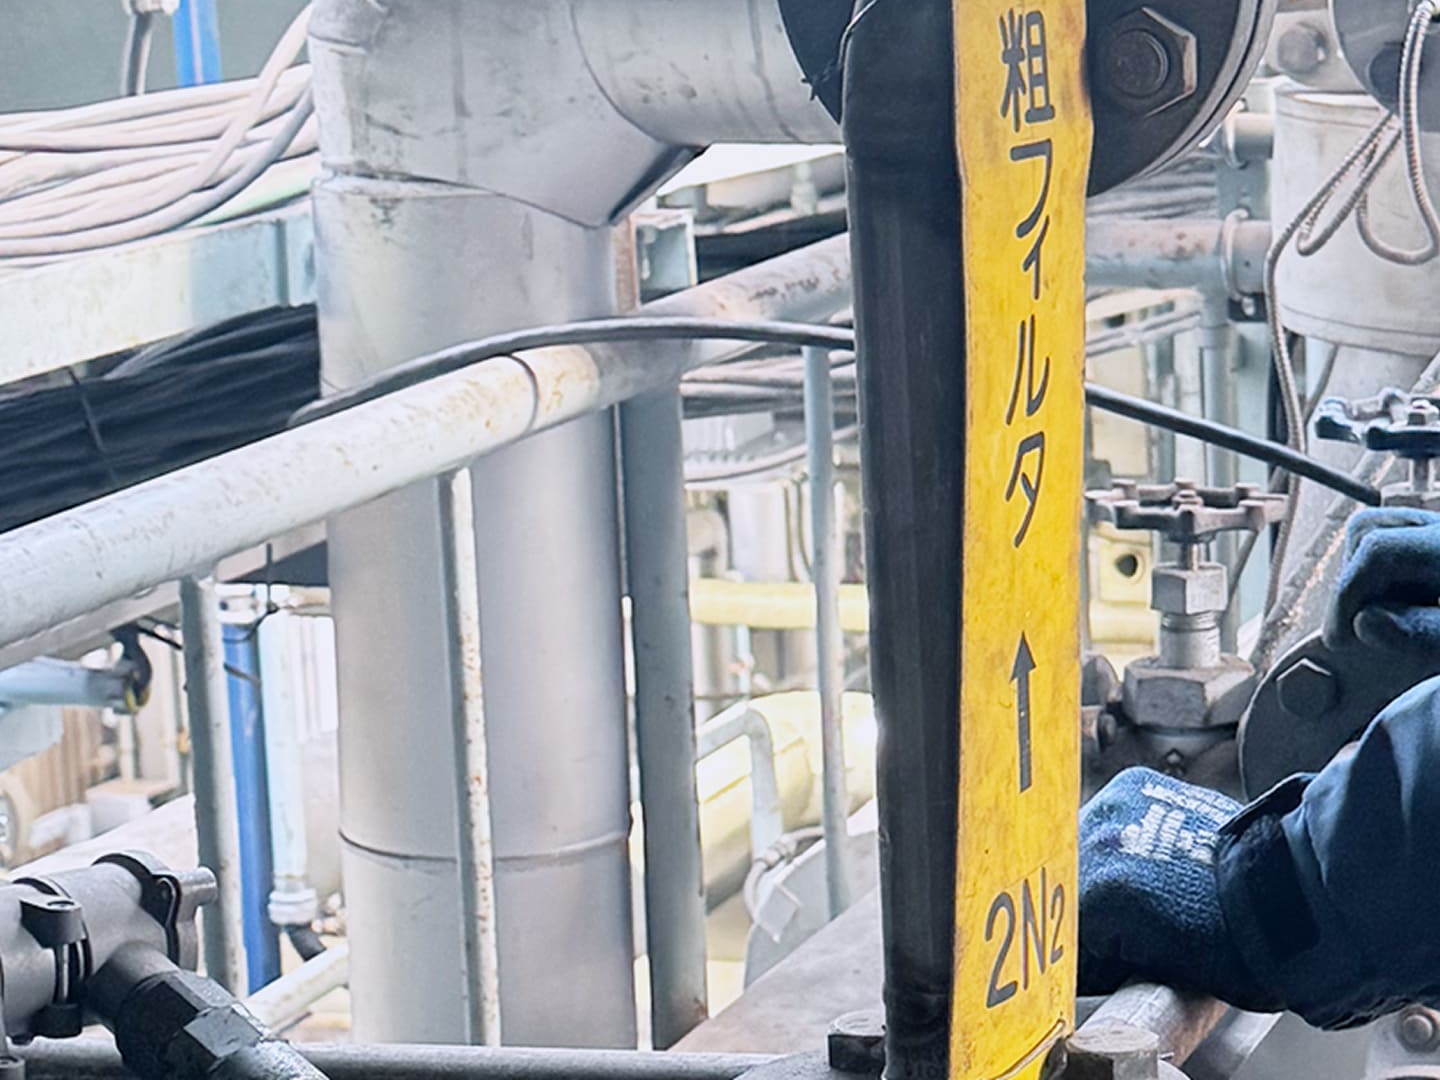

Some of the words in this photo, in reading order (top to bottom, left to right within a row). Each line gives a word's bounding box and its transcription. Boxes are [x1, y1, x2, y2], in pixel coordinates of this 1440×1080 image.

[999, 7, 1056, 548] 粗フィルタ
